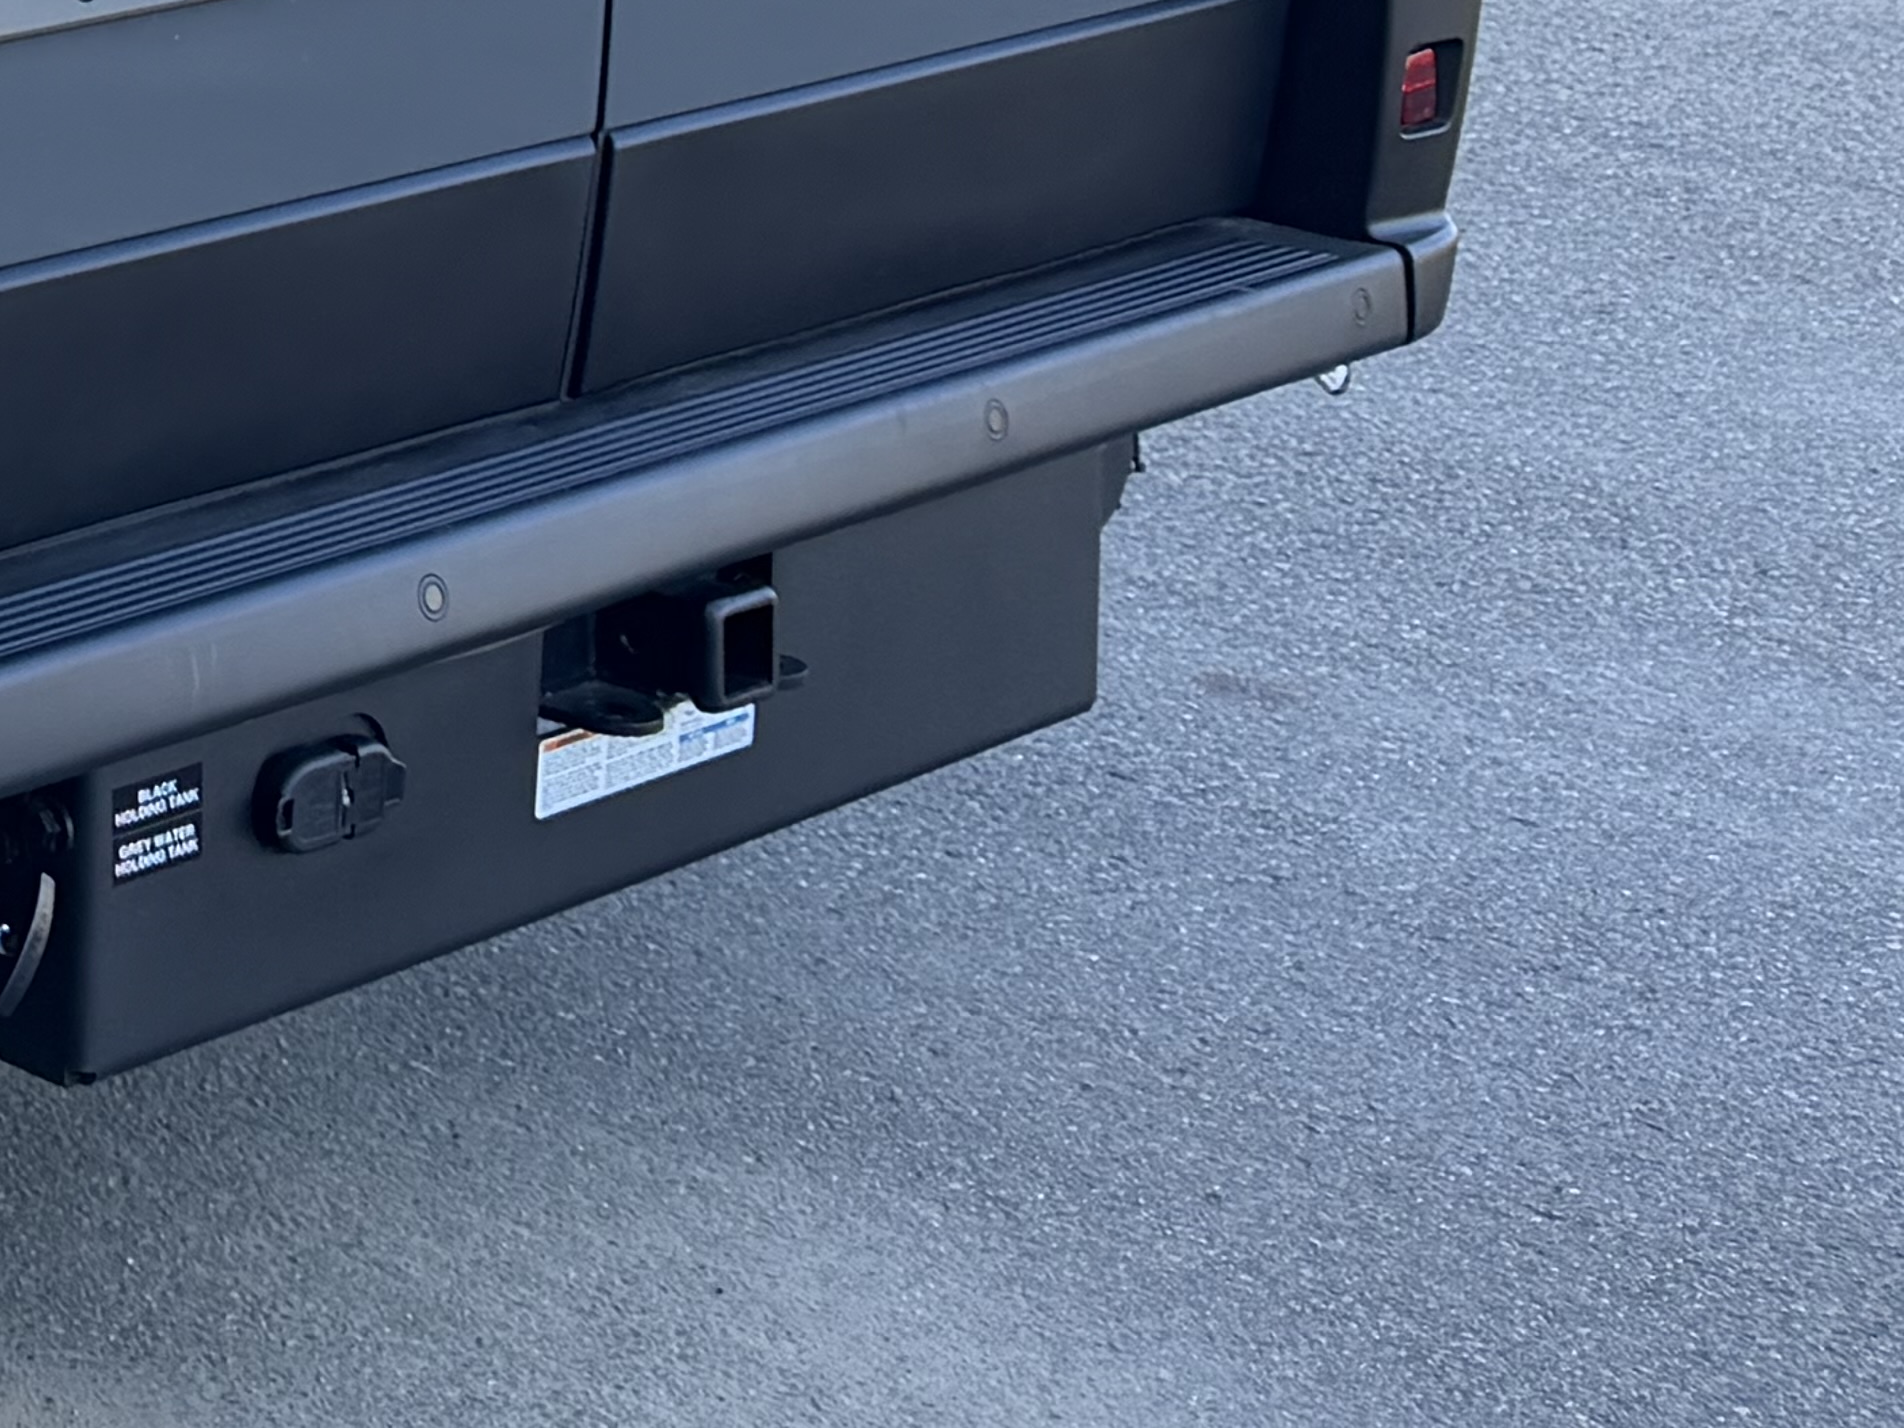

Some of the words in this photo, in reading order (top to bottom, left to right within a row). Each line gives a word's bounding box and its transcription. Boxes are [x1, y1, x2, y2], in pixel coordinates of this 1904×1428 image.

[115, 799, 168, 827] HOLDING
[169, 787, 199, 809] TANK
[137, 779, 177, 804] BLACK
[115, 849, 168, 878] HOLDING
[168, 838, 199, 859] TANK
[118, 837, 151, 859] GREY
[154, 823, 196, 847] WATER
